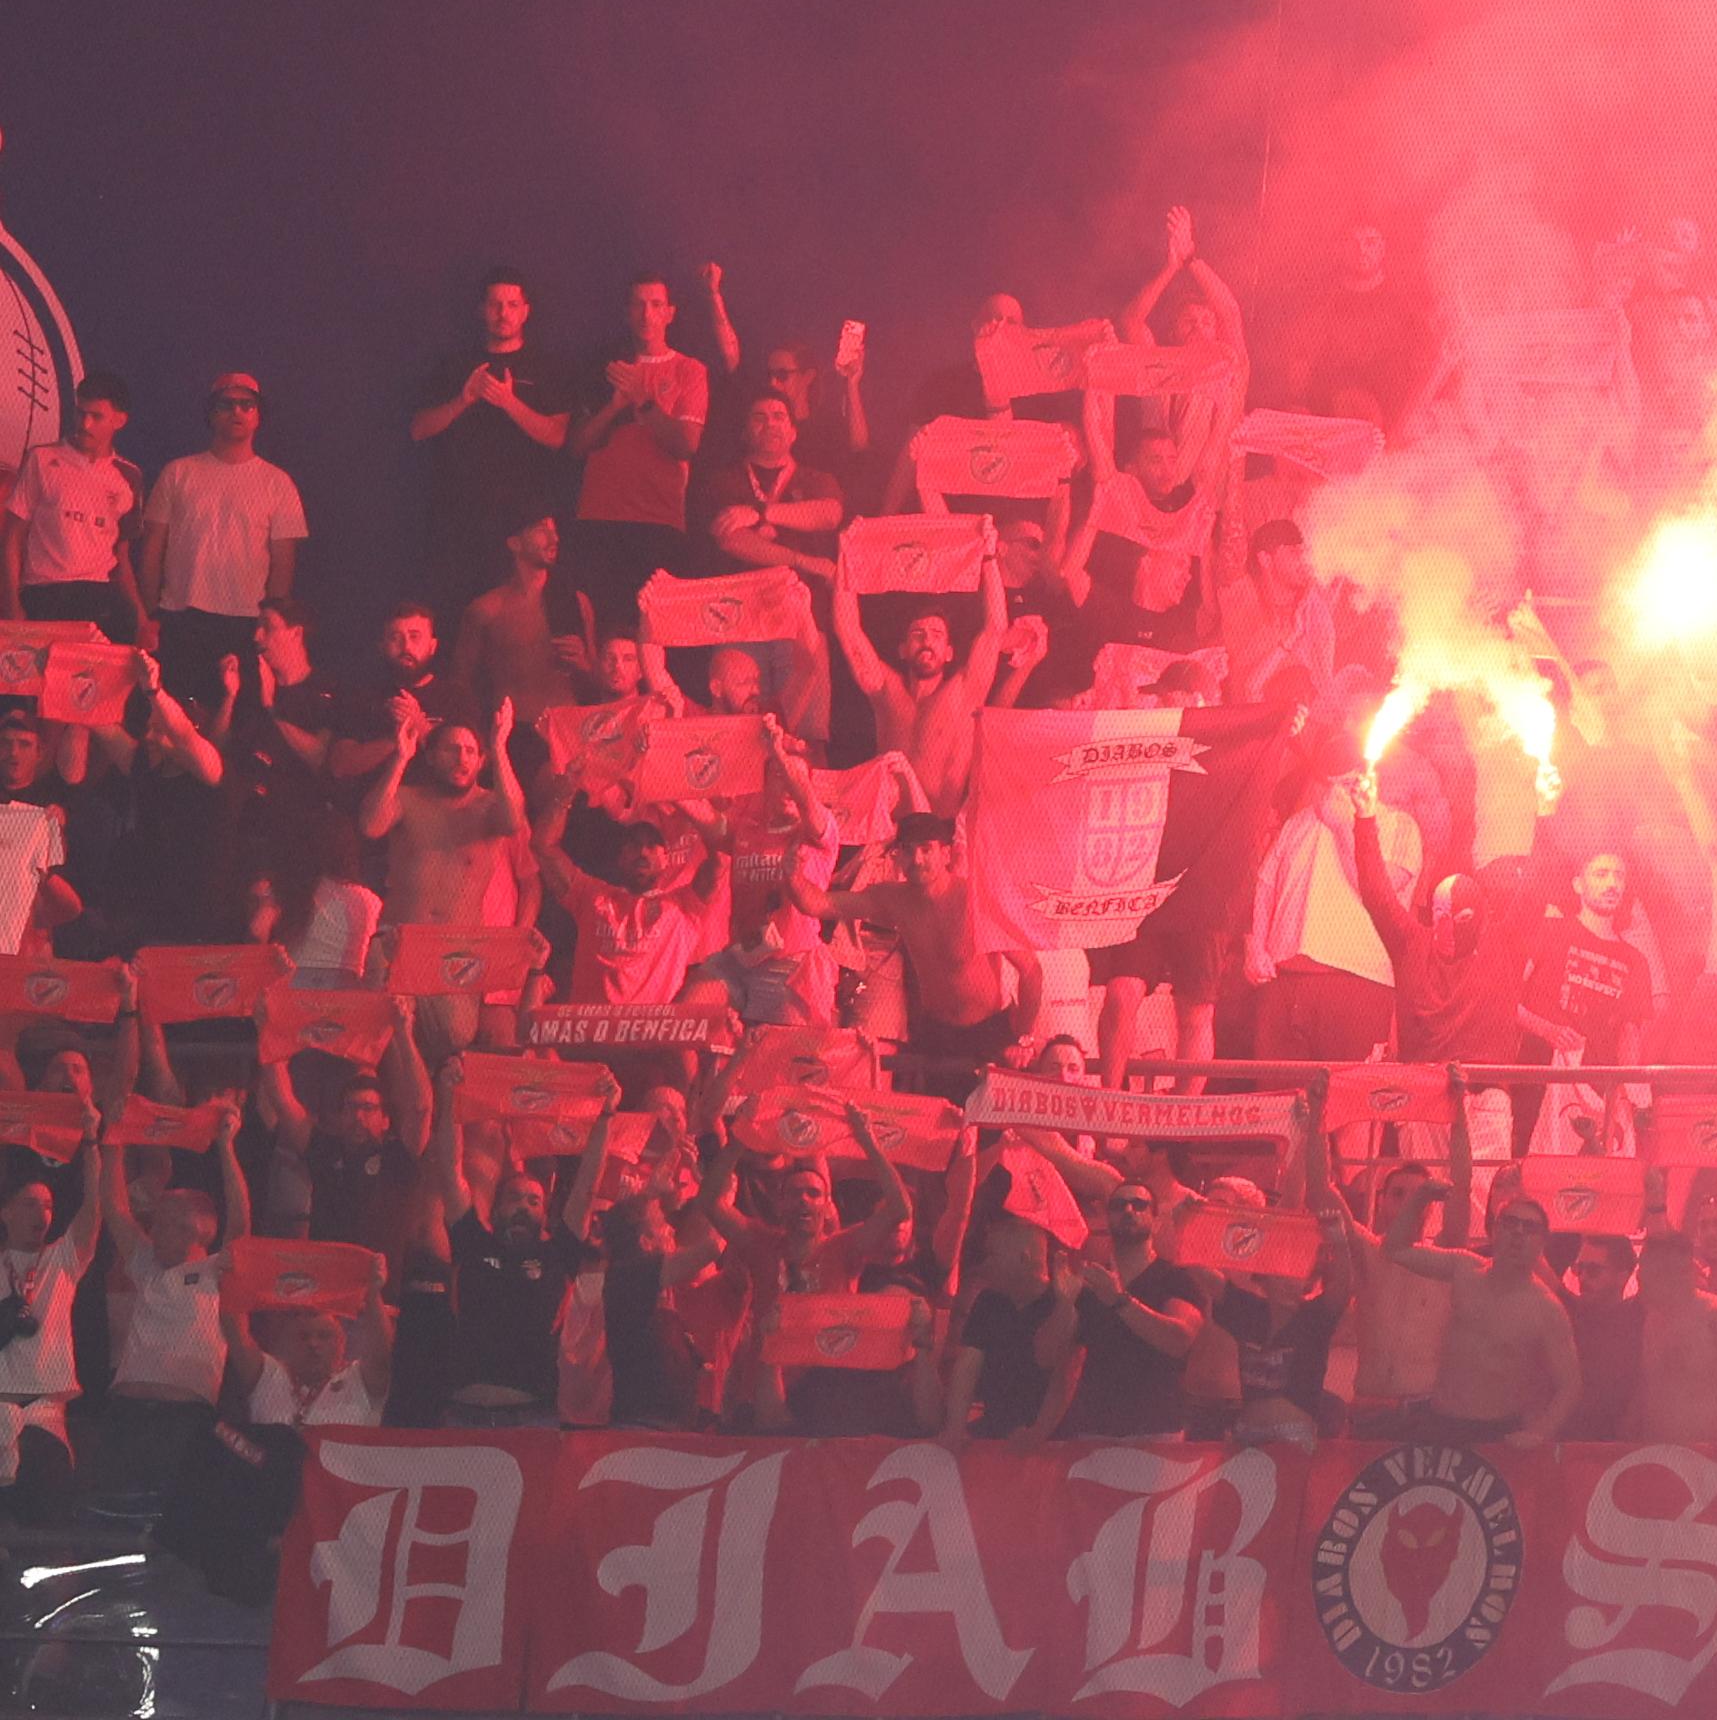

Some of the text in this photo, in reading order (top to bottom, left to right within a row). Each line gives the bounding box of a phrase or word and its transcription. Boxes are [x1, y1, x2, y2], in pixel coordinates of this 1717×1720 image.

[1082, 742, 1178, 764] DIABOS
[1055, 894, 1159, 916] BENFICA
[529, 1019, 588, 1044] AMAS
[614, 1018, 709, 1043] BENFICA
[991, 1087, 1076, 1119] DIABOS
[1315, 1480, 1379, 1653] DIABOS
[1364, 1645, 1457, 1689] 1982
